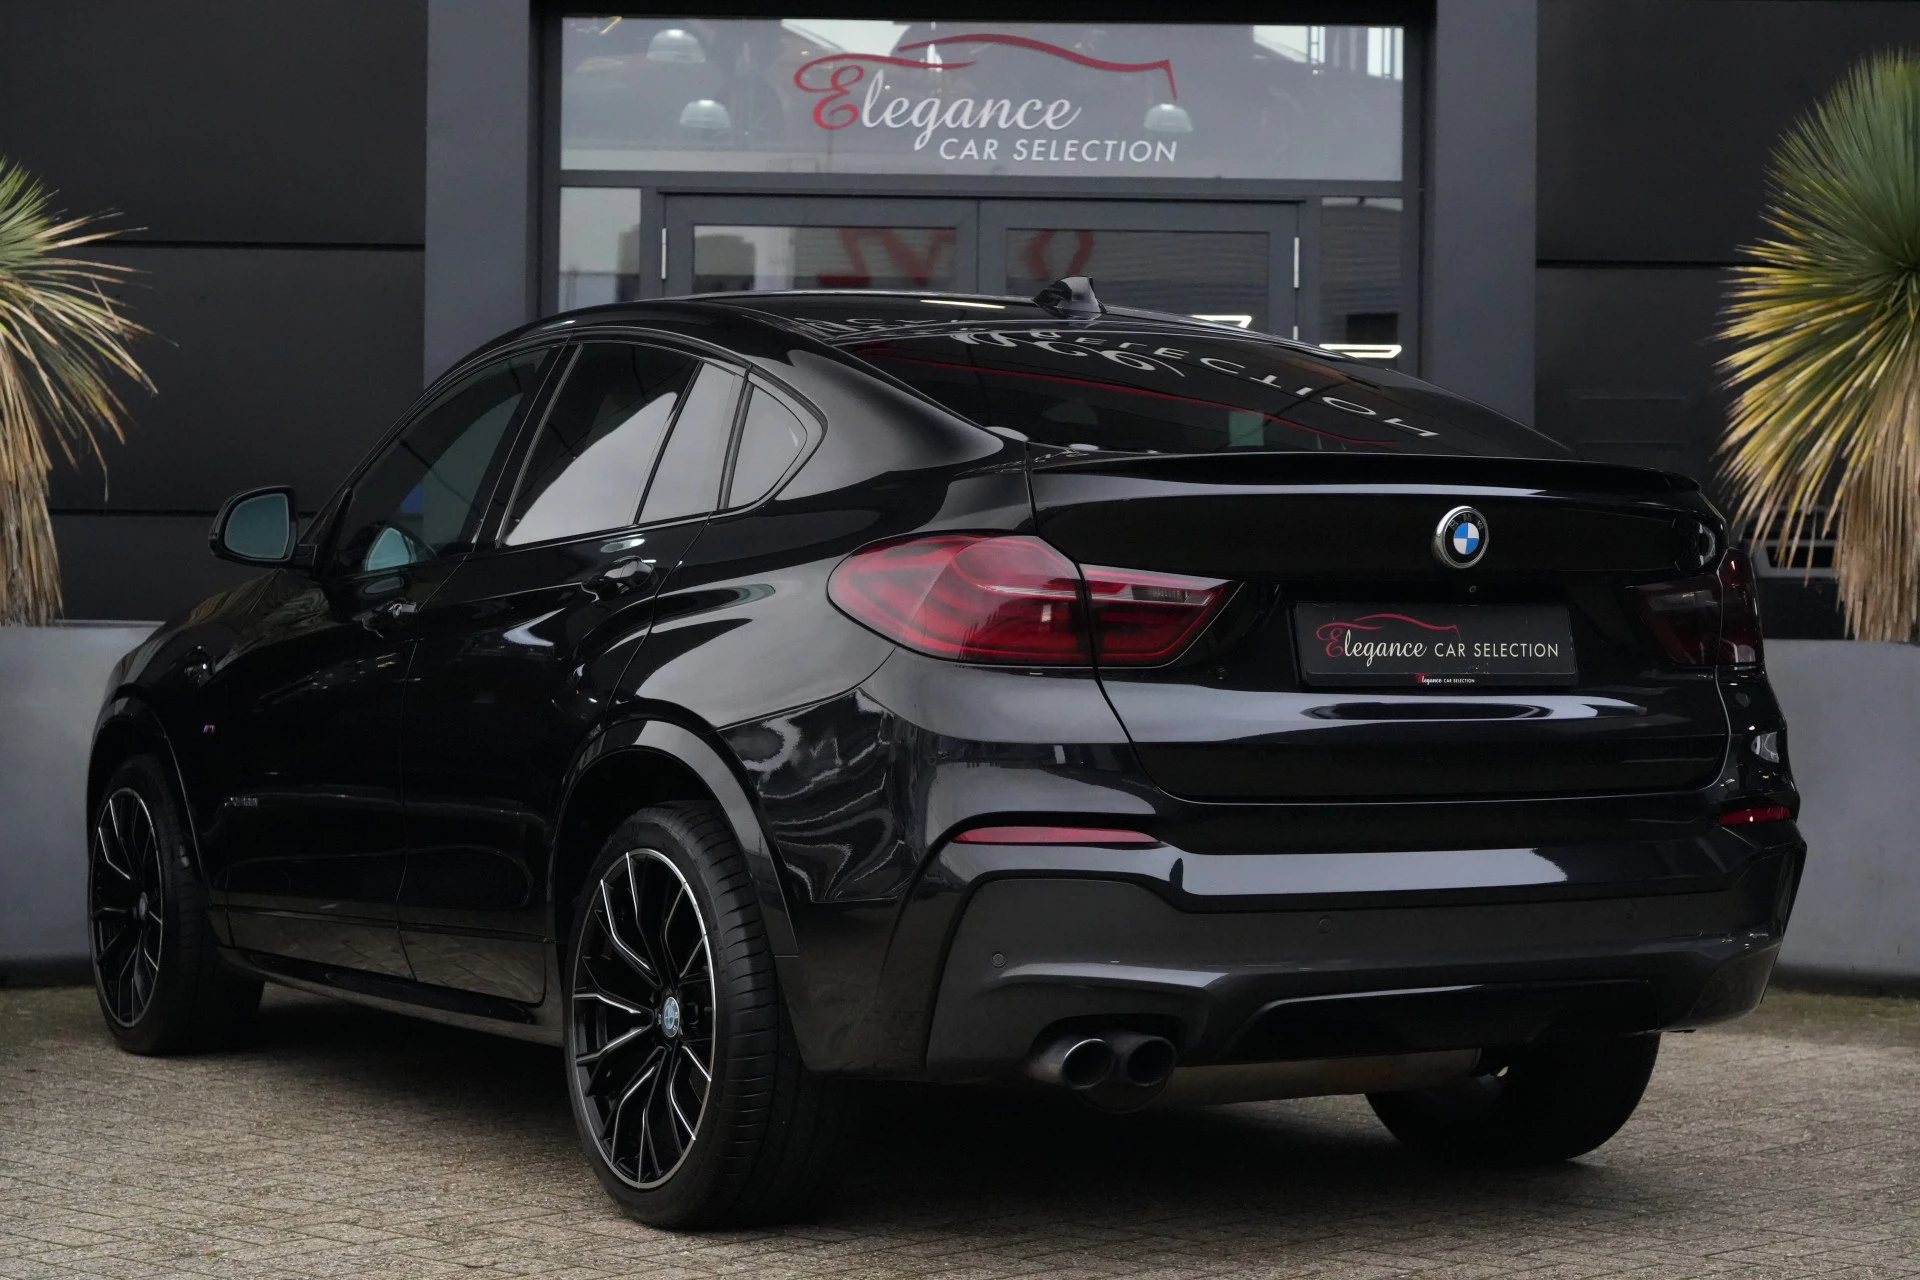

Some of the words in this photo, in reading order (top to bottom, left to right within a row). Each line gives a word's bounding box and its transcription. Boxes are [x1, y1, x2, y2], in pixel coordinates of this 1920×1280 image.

[795, 56, 1081, 151] Elegance
[939, 138, 999, 160] CAR
[1013, 140, 1178, 162] SELECTION
[1316, 625, 1427, 666] Elegance
[1434, 642, 1466, 657] CAR
[1473, 643, 1559, 658] SELECTION
